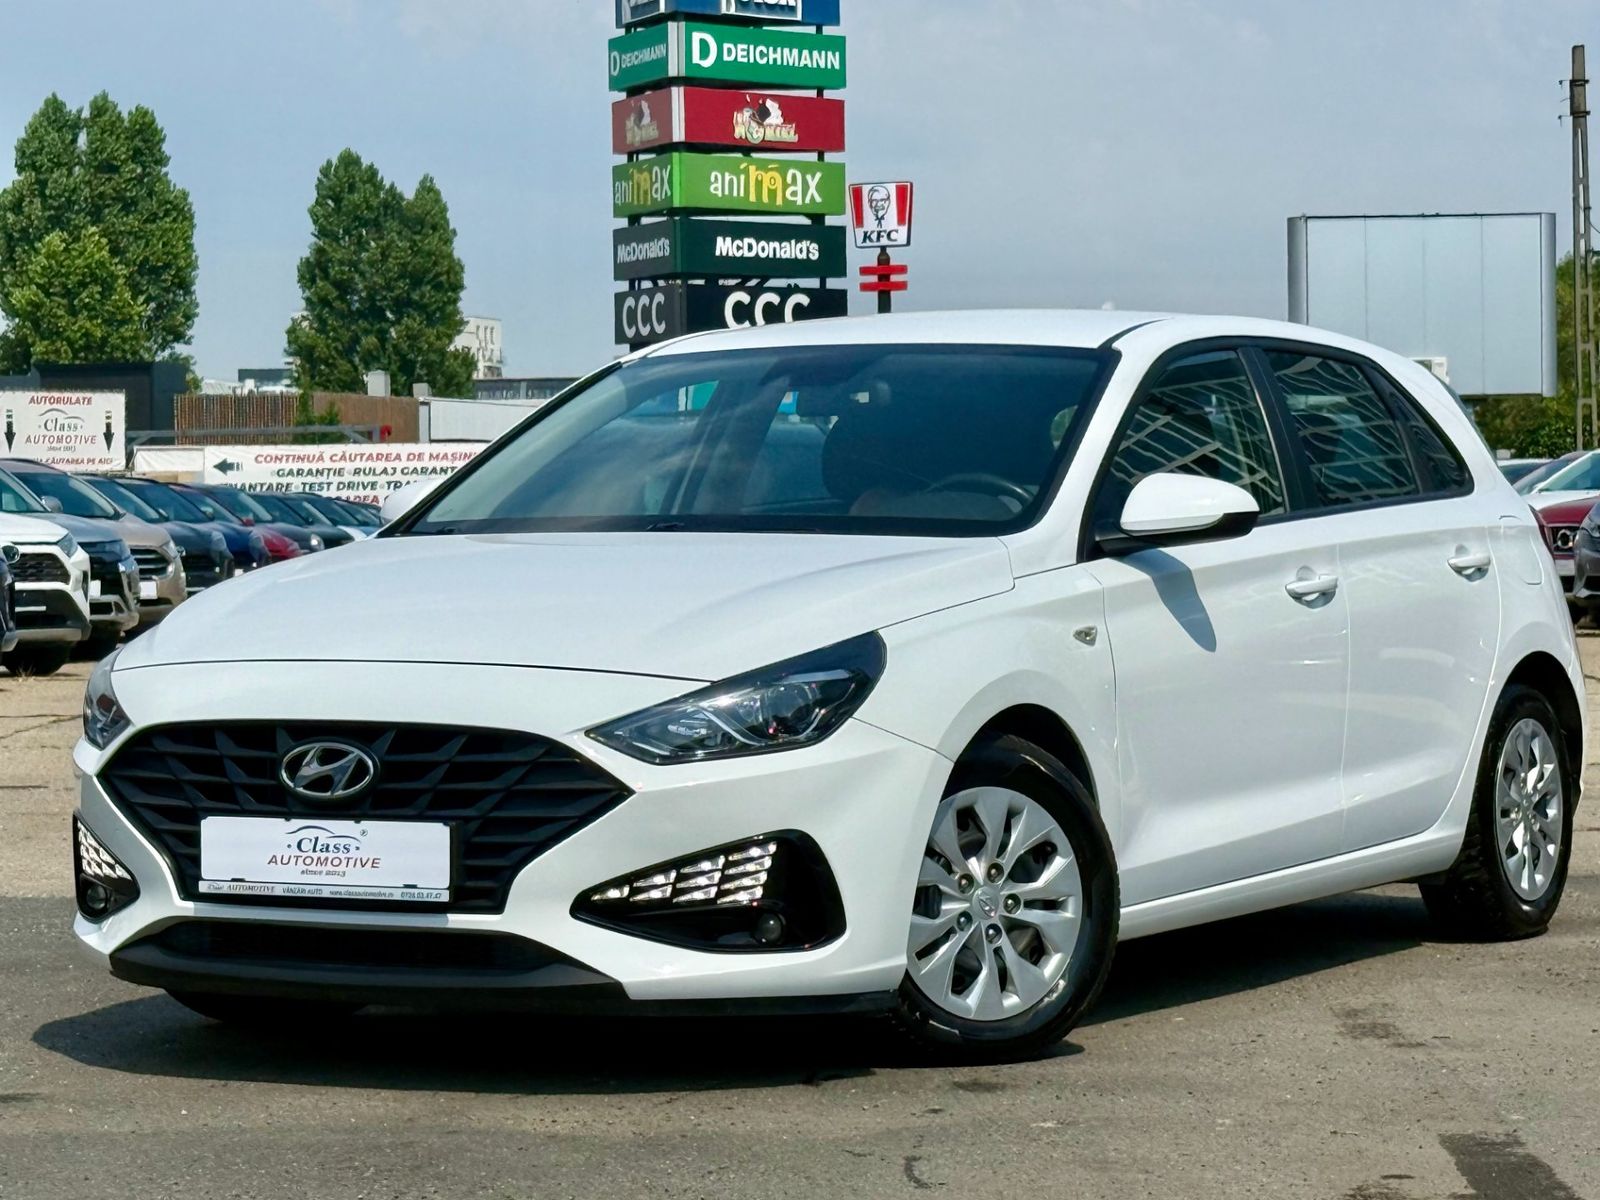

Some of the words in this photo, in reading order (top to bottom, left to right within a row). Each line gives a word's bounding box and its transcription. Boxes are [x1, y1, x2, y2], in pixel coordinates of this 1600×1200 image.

[621, 43, 667, 68] DEICHMANN
[691, 31, 717, 68] D
[722, 43, 840, 70] DEICHMANN
[710, 163, 823, 207] animax
[861, 228, 899, 244] KFC
[617, 237, 670, 264] McDonald's
[715, 236, 819, 261] McDonald's
[622, 292, 666, 339] CCC
[724, 291, 811, 330] CCC
[28, 395, 93, 406] AUTORULATE
[43, 417, 78, 432] Class
[25, 434, 97, 445] AUTOMOTIVE
[254, 451, 325, 464] CONTINUĂ
[329, 450, 402, 464] CĂUTAREA
[406, 452, 425, 463] DE
[276, 467, 345, 479] GARANȚIE
[352, 466, 398, 477] RULAJ
[301, 481, 333, 492] TEST
[336, 481, 379, 492] DRIVE
[296, 836, 351, 854] Class
[267, 854, 381, 869] AUTOMOTIVE
[226, 884, 276, 893] AUTOMOTIVE
